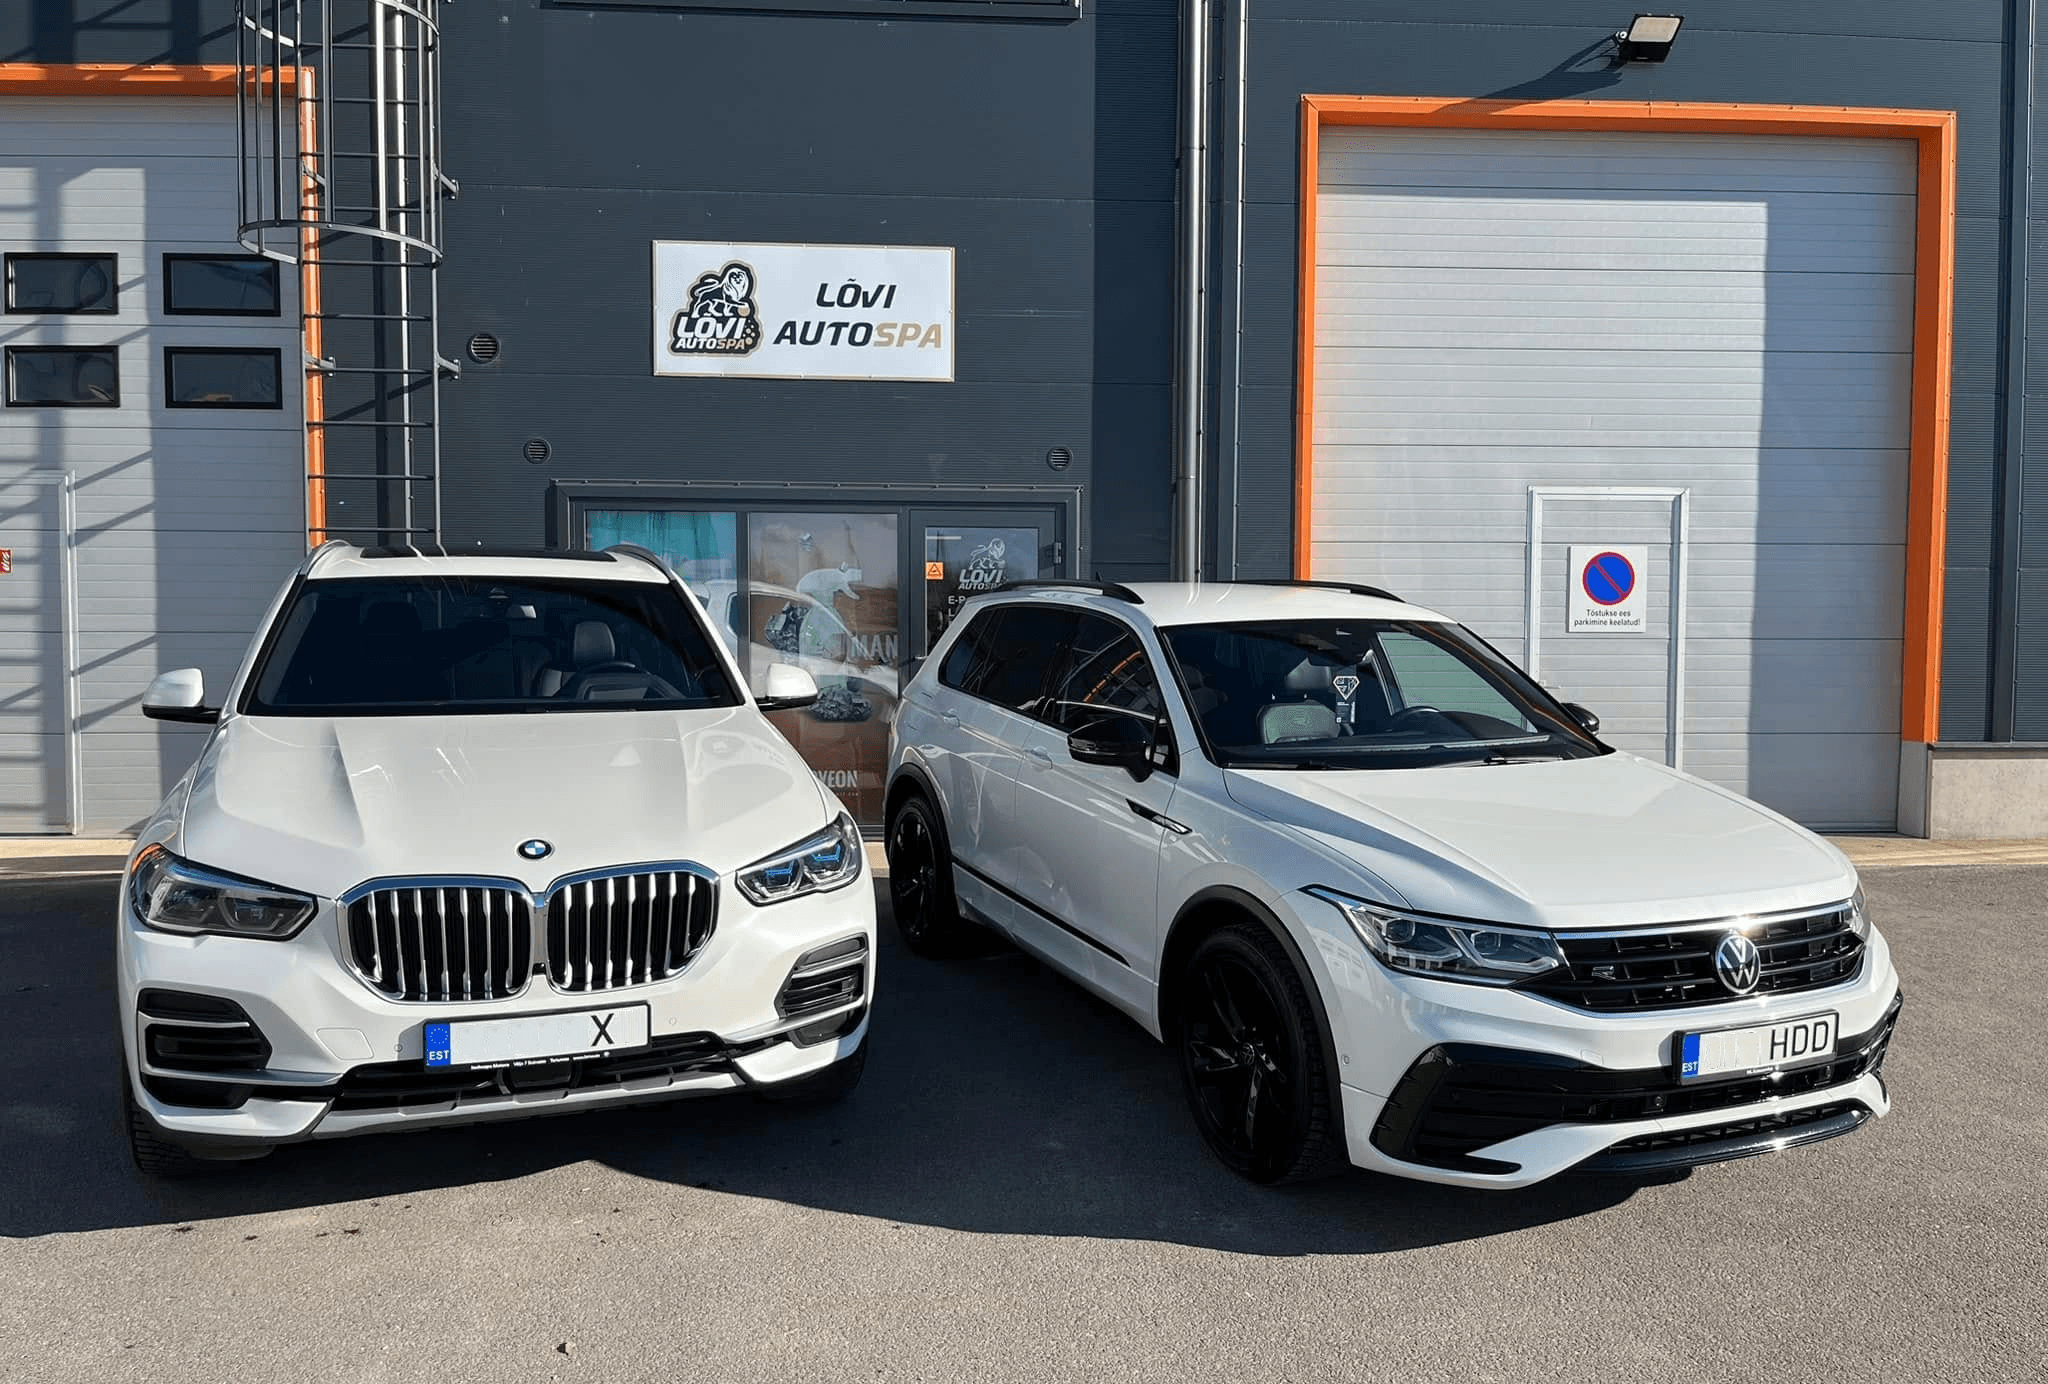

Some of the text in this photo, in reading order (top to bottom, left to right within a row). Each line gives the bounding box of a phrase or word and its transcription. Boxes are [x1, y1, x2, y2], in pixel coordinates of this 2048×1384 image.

[816, 278, 897, 309] LÕVI
[675, 338, 746, 350] AUTOSPA
[773, 320, 943, 348] AUTOSPA
[1574, 618, 1641, 627] parkimine keelatud!
[429, 1013, 614, 1060] EST X
[1682, 1020, 1829, 1073] EST HDD
